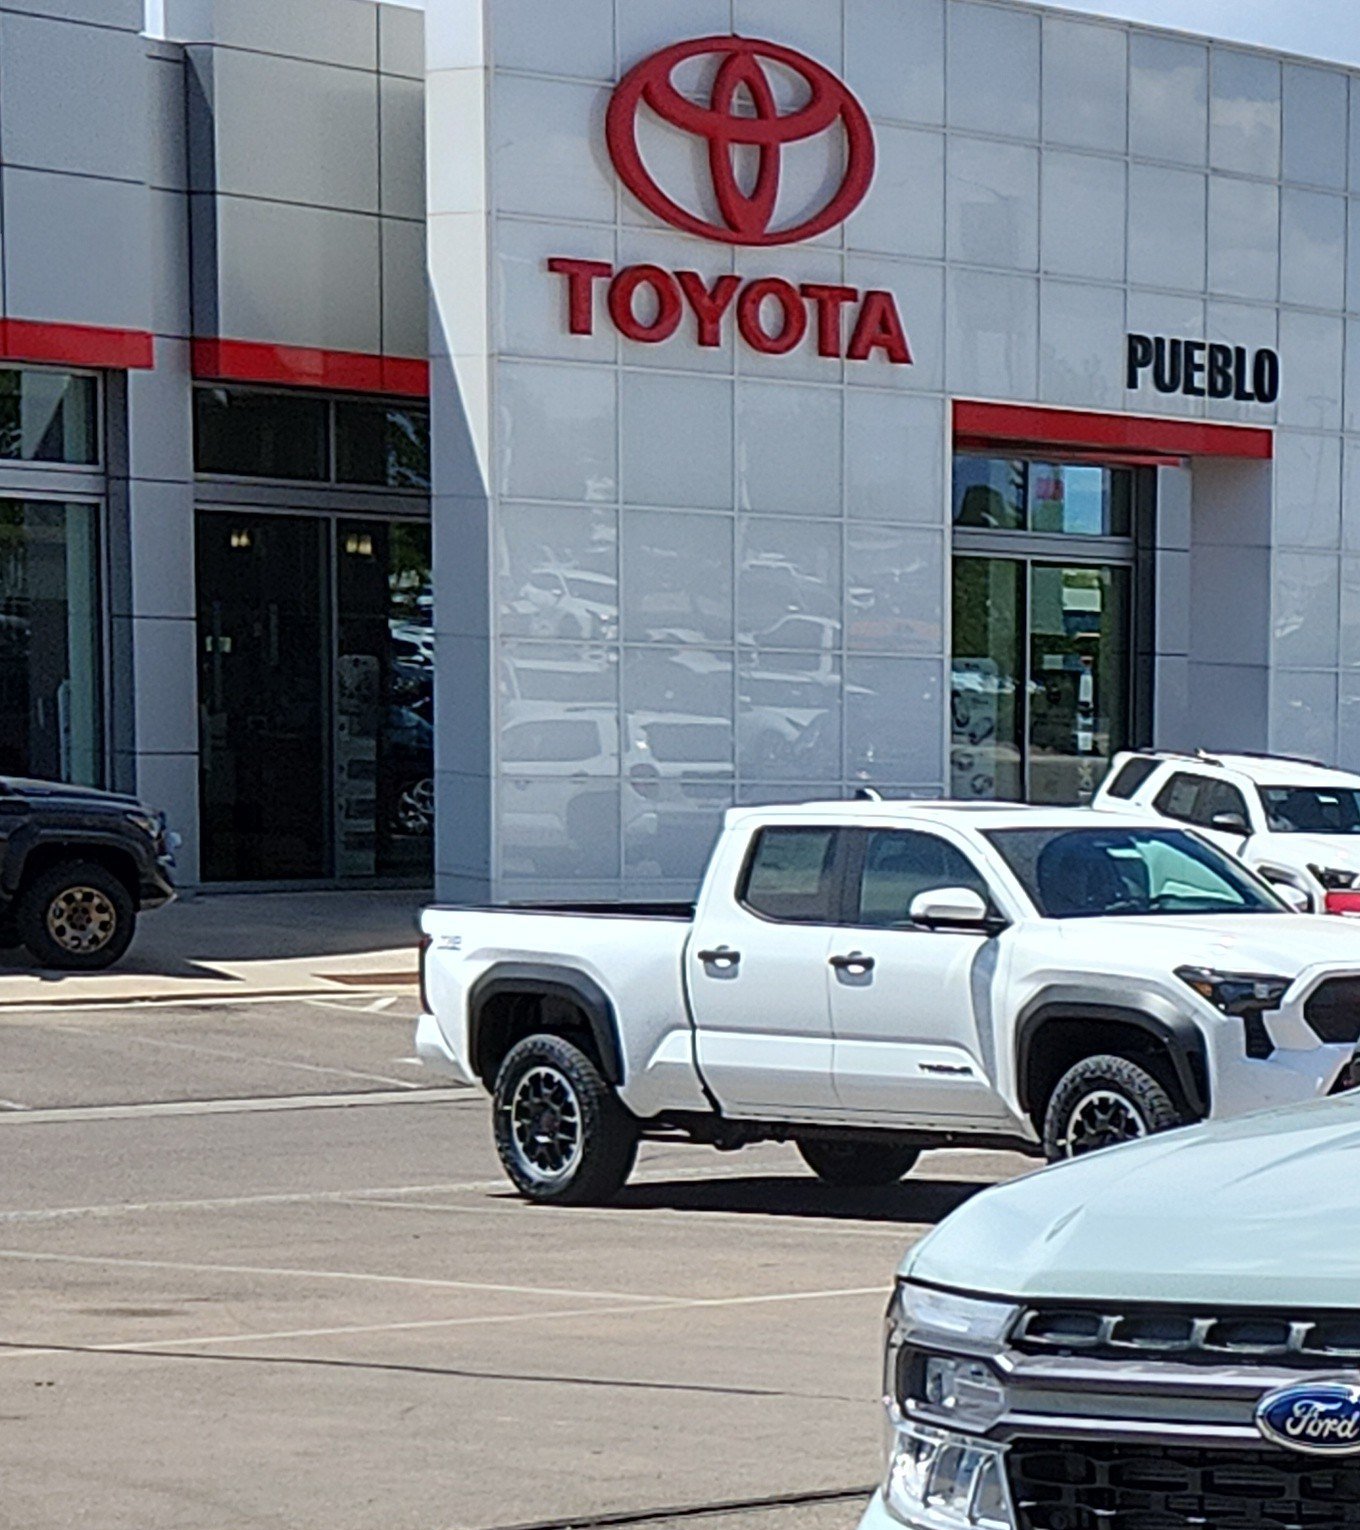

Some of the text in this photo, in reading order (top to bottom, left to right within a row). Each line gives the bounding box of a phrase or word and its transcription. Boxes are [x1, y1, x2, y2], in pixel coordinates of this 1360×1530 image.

[547, 257, 914, 365] TOYOTA
[1126, 333, 1281, 404] PUEBLO
[1285, 1399, 1360, 1439] Ford
